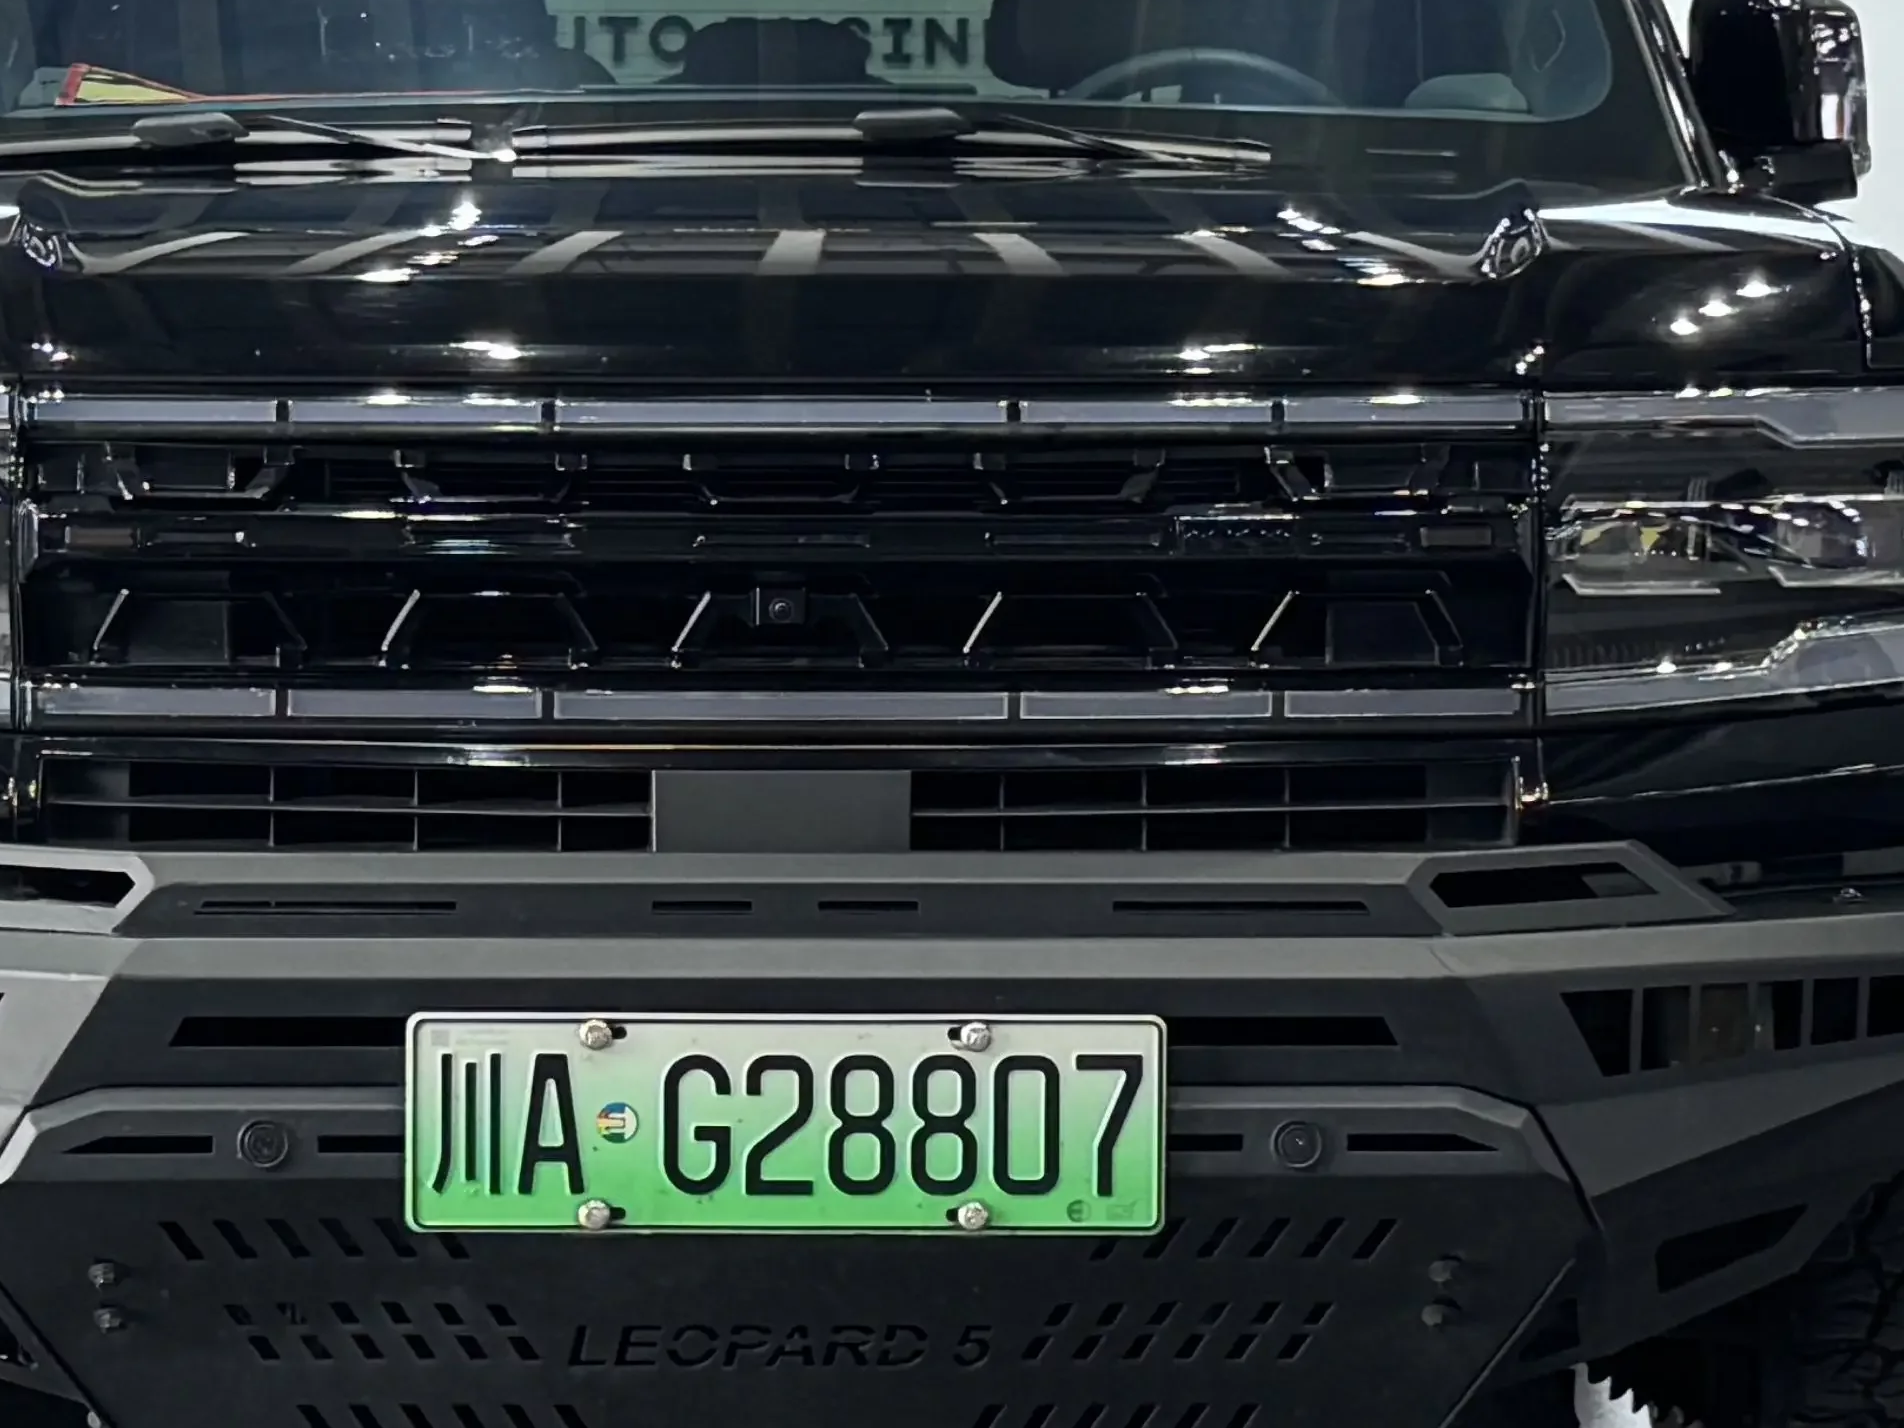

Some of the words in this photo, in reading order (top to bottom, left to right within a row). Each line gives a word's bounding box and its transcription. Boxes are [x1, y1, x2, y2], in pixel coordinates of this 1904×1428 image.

[429, 1052, 586, 1196] 川A
[662, 1053, 1144, 1197] G28807
[567, 1323, 929, 1368] LEOPARD
[952, 1324, 993, 1368] 5
